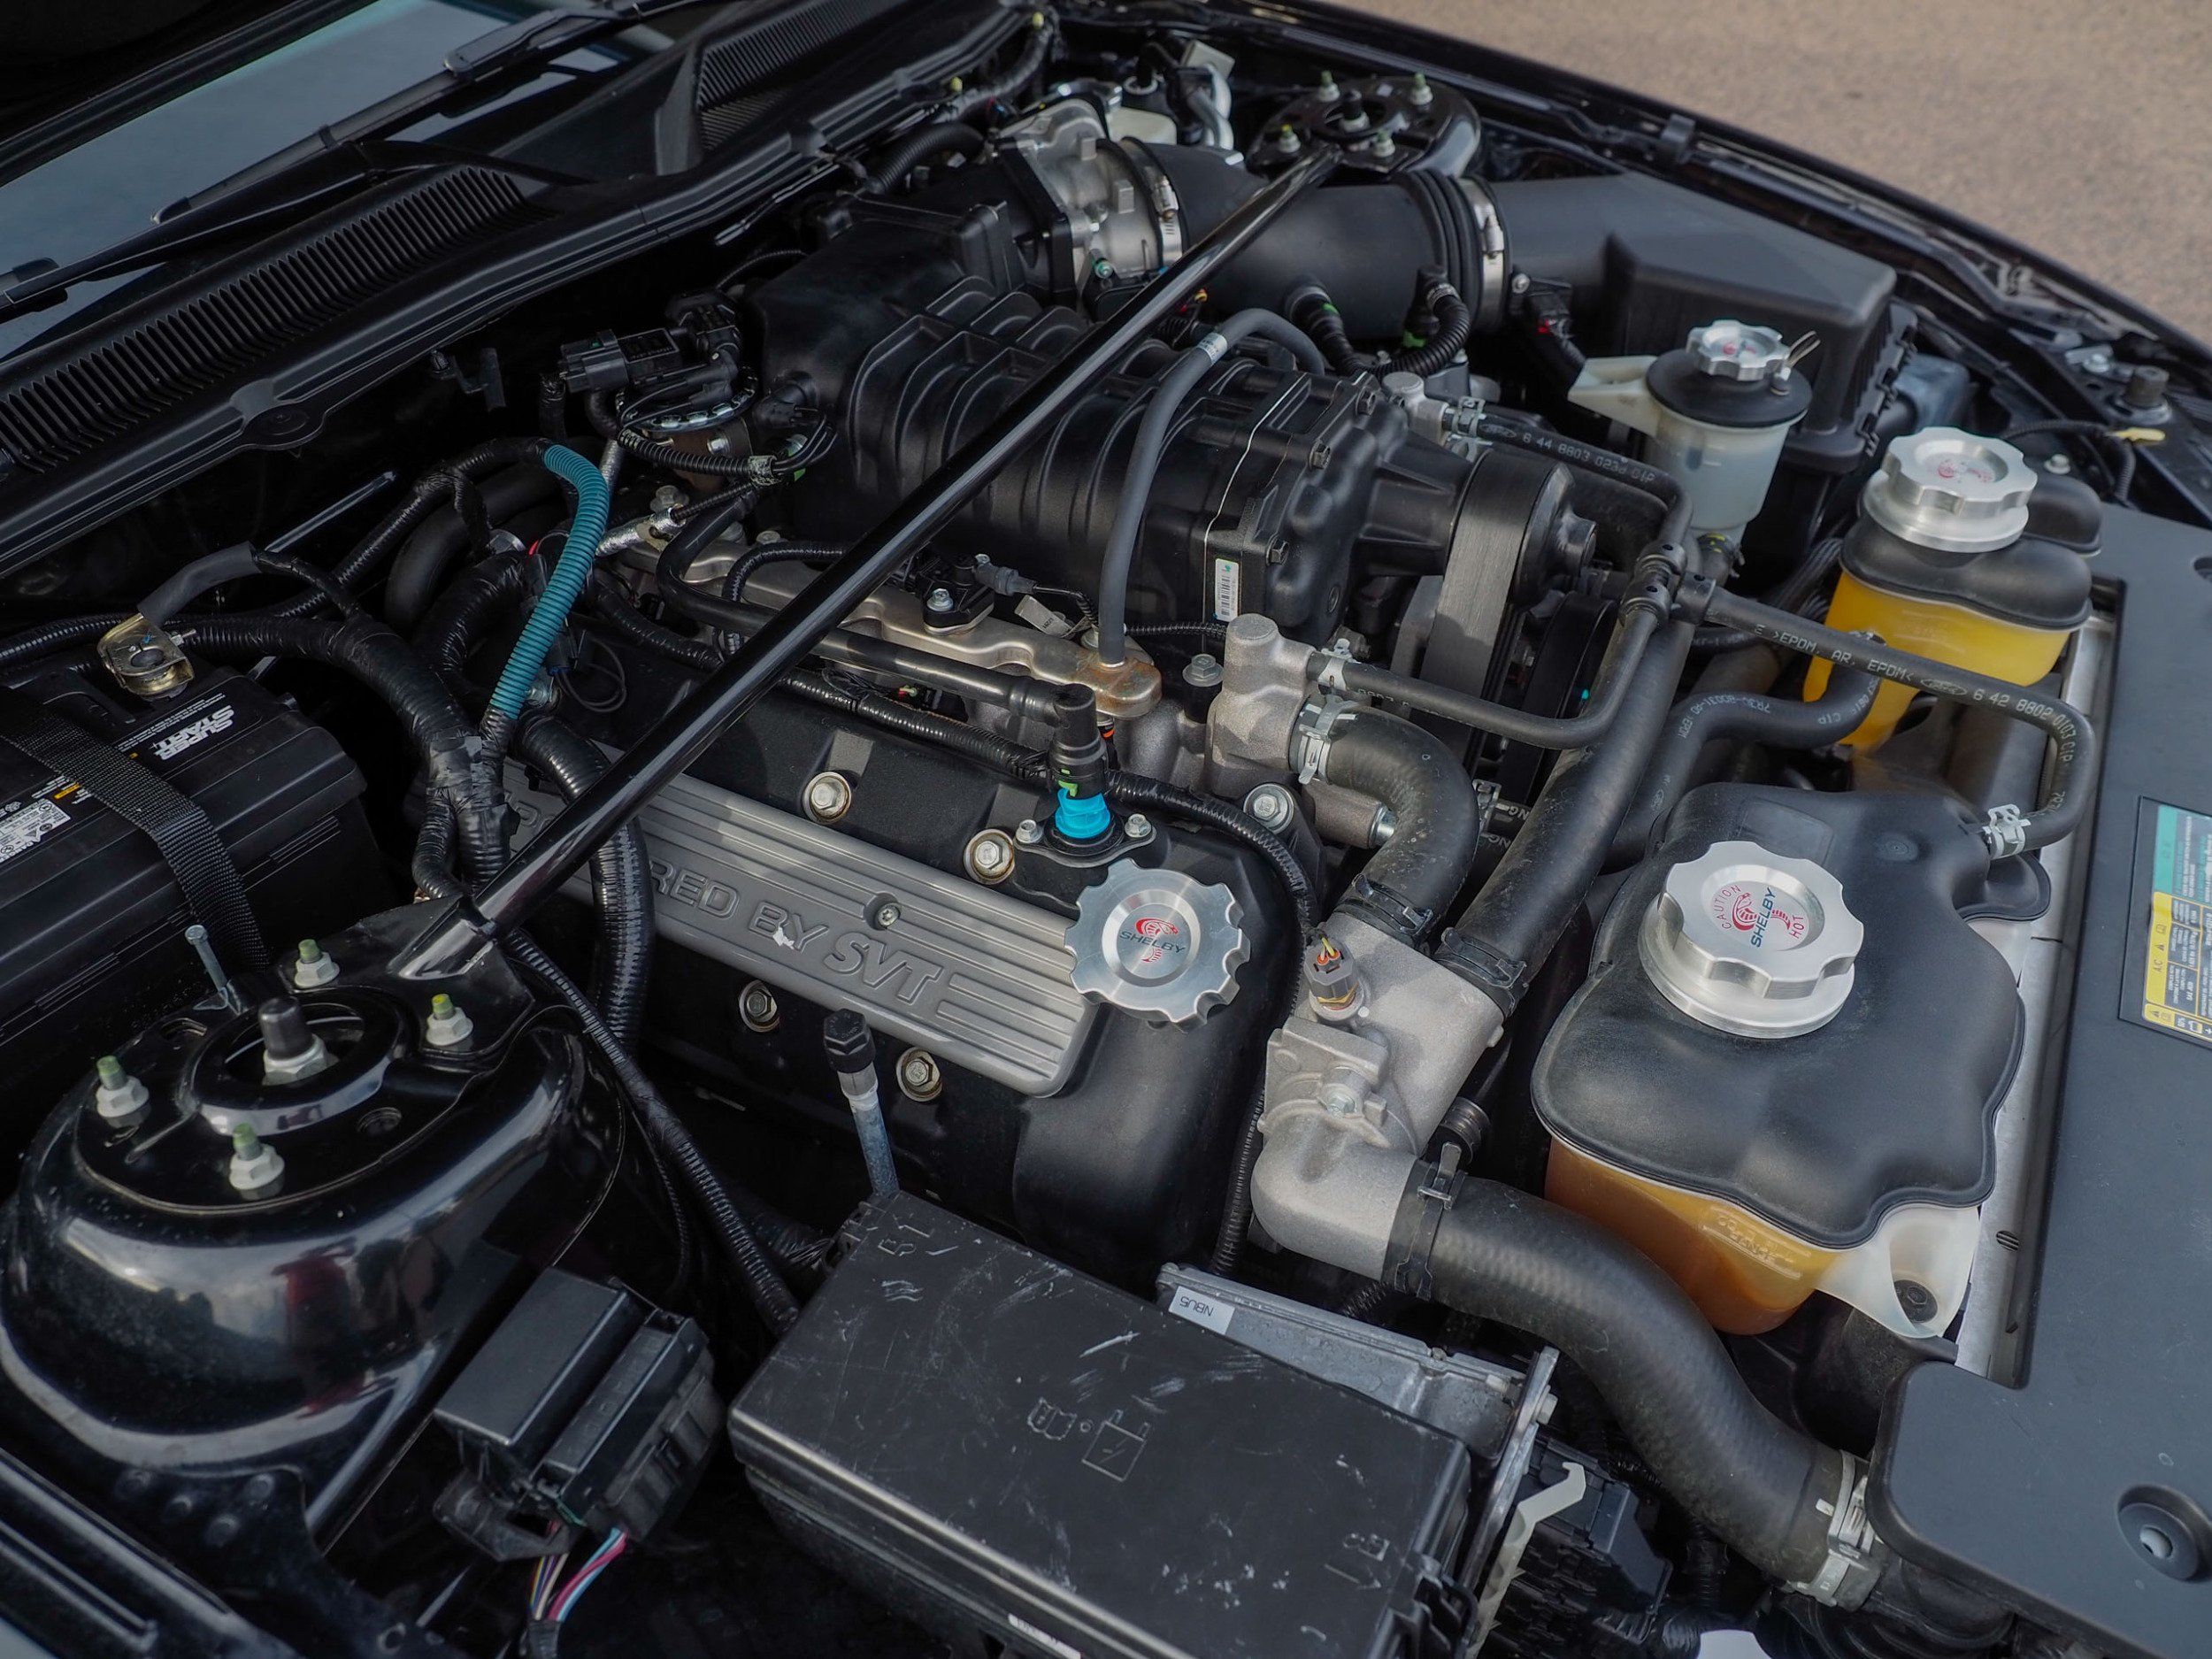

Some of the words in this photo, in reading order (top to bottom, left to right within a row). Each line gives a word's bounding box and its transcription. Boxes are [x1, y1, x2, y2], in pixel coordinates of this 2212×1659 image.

[1535, 435, 1553, 450] 44
[1972, 686, 1986, 702] 6
[1987, 690, 2011, 709] 42
[2015, 697, 2054, 722] 8802
[155, 718, 234, 761] SUPER
[157, 705, 236, 749] START
[1712, 885, 1741, 930] CAUTION
[1750, 887, 1777, 948] SHELBY
[1789, 915, 1805, 939] HOT
[748, 902, 828, 953] BY
[824, 932, 943, 1005] SVT
[1119, 929, 1188, 956] SHELBY
[1179, 1295, 1214, 1317] NBU5
